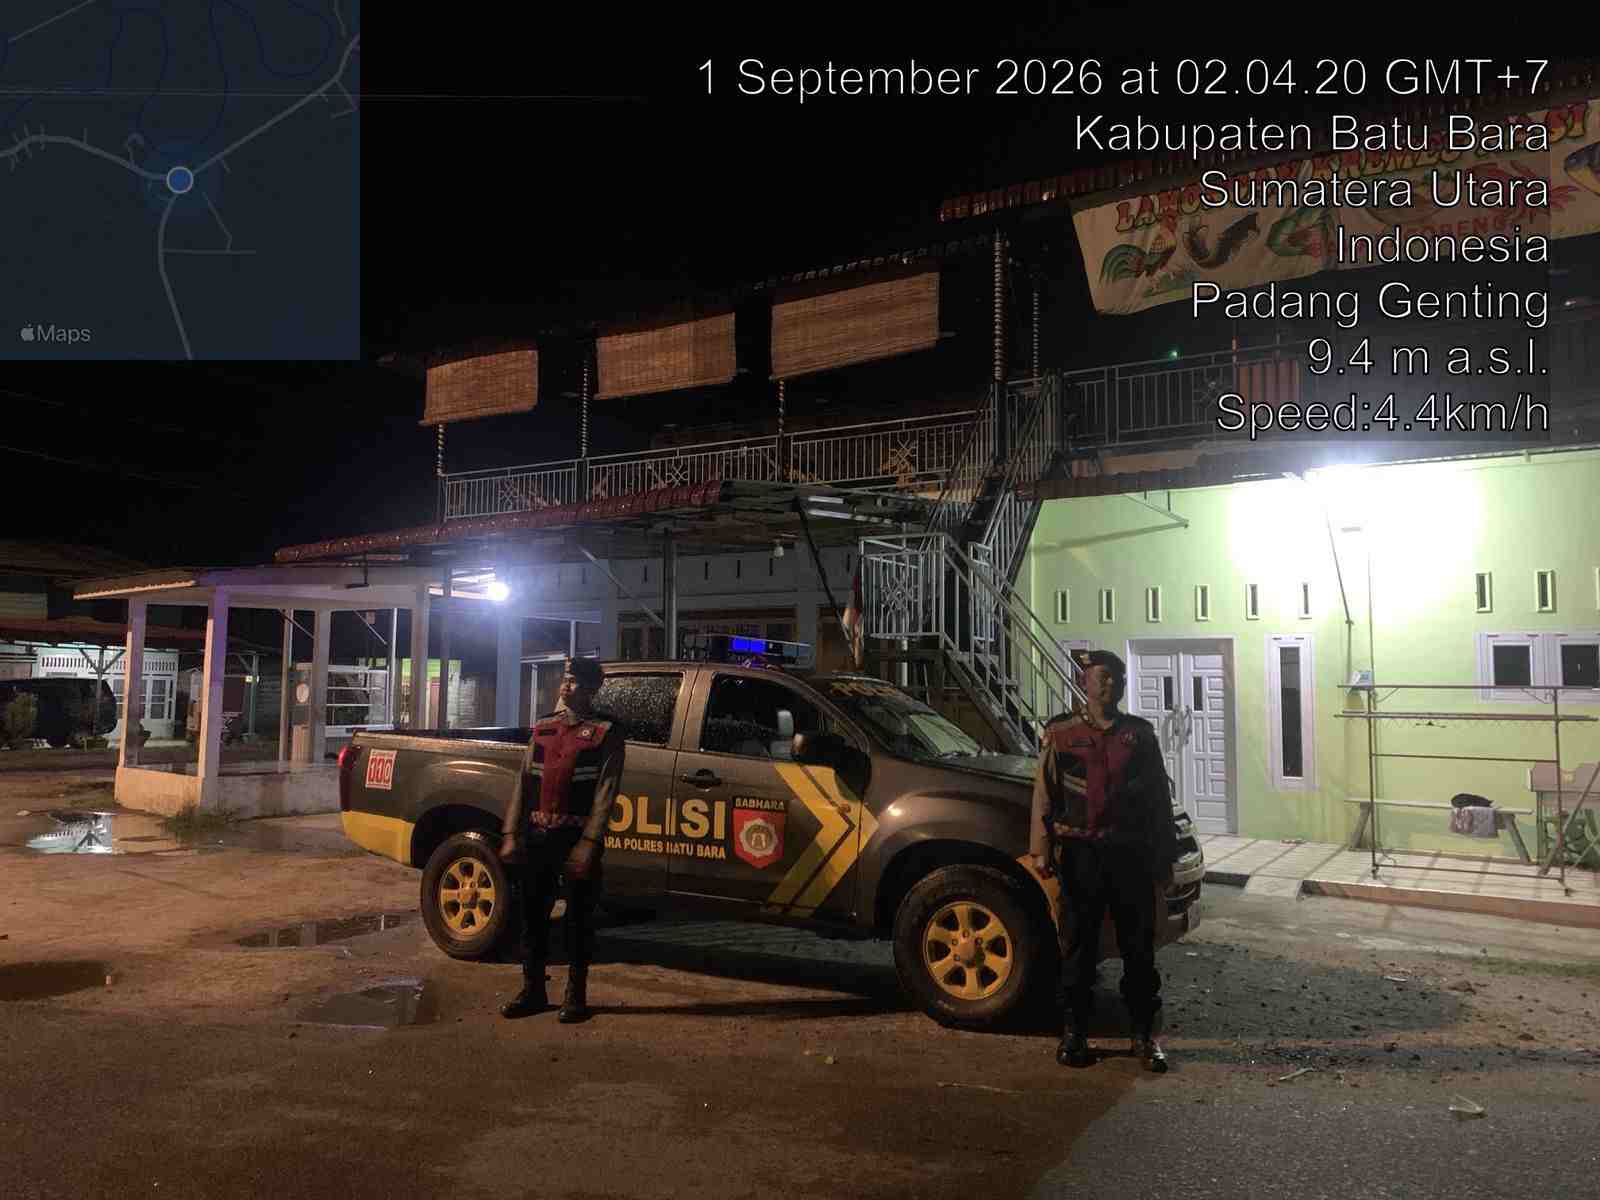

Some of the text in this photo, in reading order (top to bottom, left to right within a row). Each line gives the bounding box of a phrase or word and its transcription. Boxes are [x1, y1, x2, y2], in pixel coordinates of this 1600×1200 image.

[608, 793, 726, 841] OLISI
[623, 837, 664, 854] POLRES
[665, 841, 694, 857] BATU
[696, 843, 726, 860] BARA
